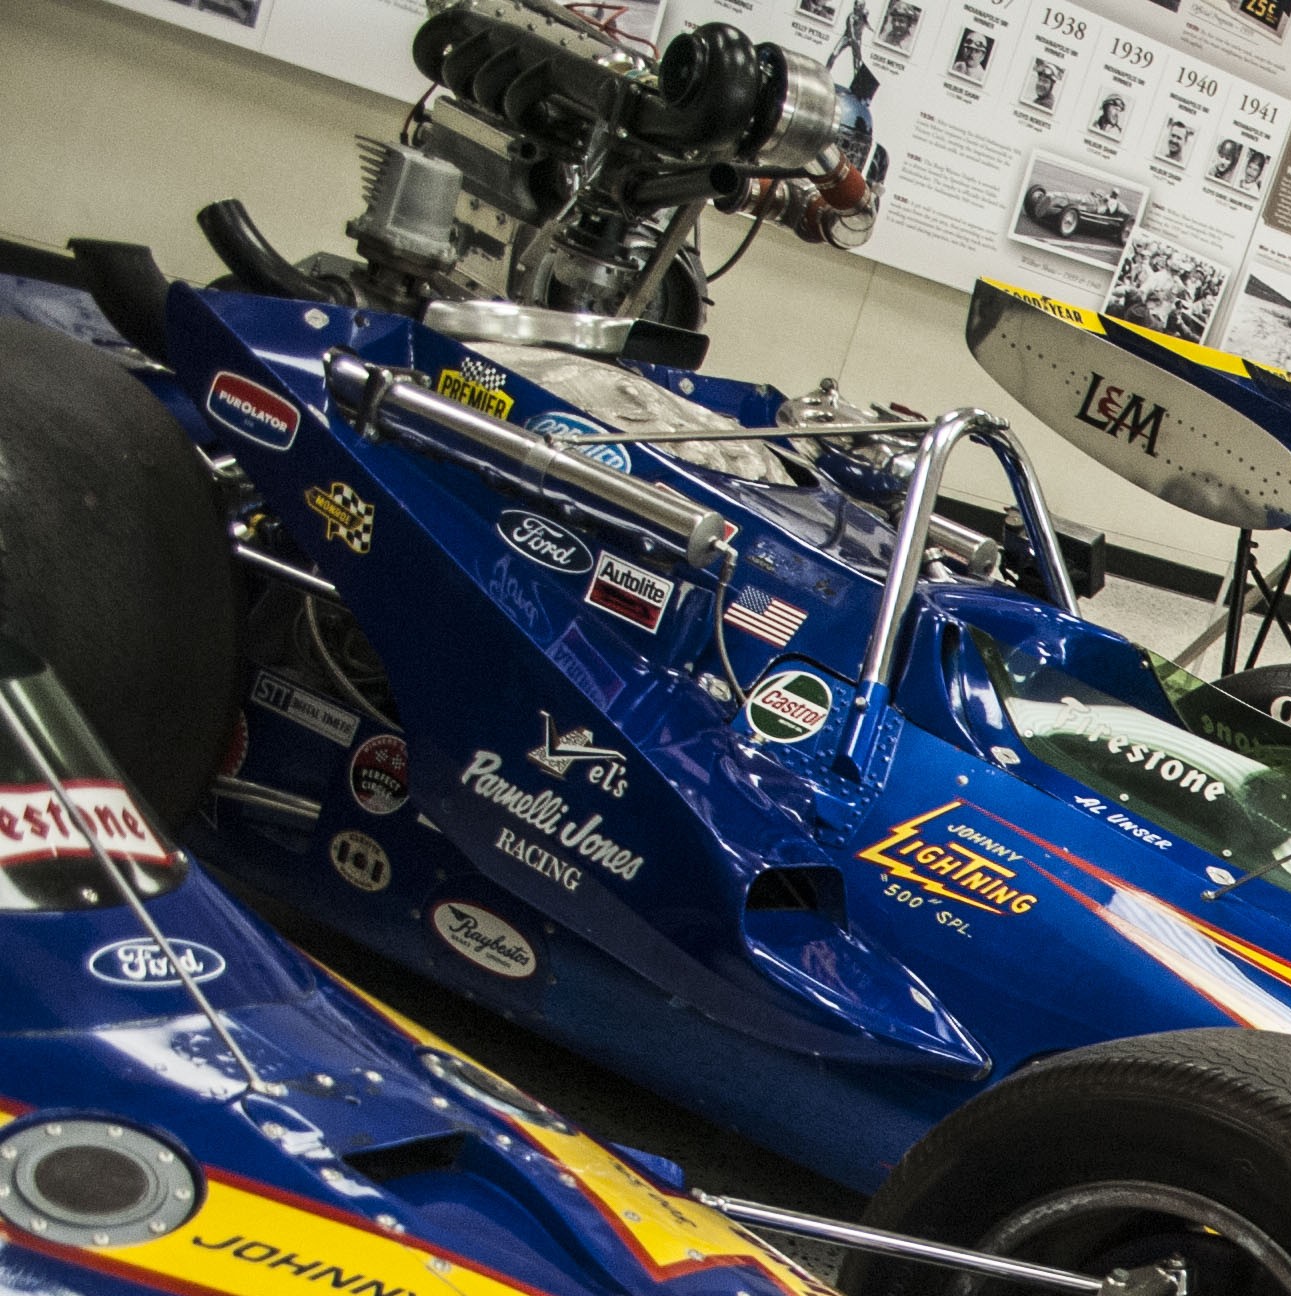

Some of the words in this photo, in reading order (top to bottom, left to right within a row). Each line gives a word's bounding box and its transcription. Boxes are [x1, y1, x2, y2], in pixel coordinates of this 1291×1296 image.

[1041, 7, 1088, 40] 1938
[1110, 37, 1155, 69] 1939
[1175, 67, 1219, 97] 1940
[1238, 94, 1279, 125] 1941
[1003, 288, 1084, 325] OODYEAR
[218, 391, 288, 433] PUROLATOR
[441, 373, 507, 420] PREMIER
[512, 516, 577, 566] Ford
[600, 560, 665, 604] Autolite
[761, 690, 827, 727] Castrol
[1051, 695, 1226, 802] Firestone
[460, 750, 568, 835] Parnelli
[560, 814, 645, 881] Jones
[1073, 796, 1104, 816] AL
[1106, 814, 1173, 851] UNSER
[495, 828, 582, 891] RACING
[856, 800, 1038, 916] LIGHTNING
[945, 822, 1024, 861] JOHNNY
[448, 915, 530, 966] Raybestos
